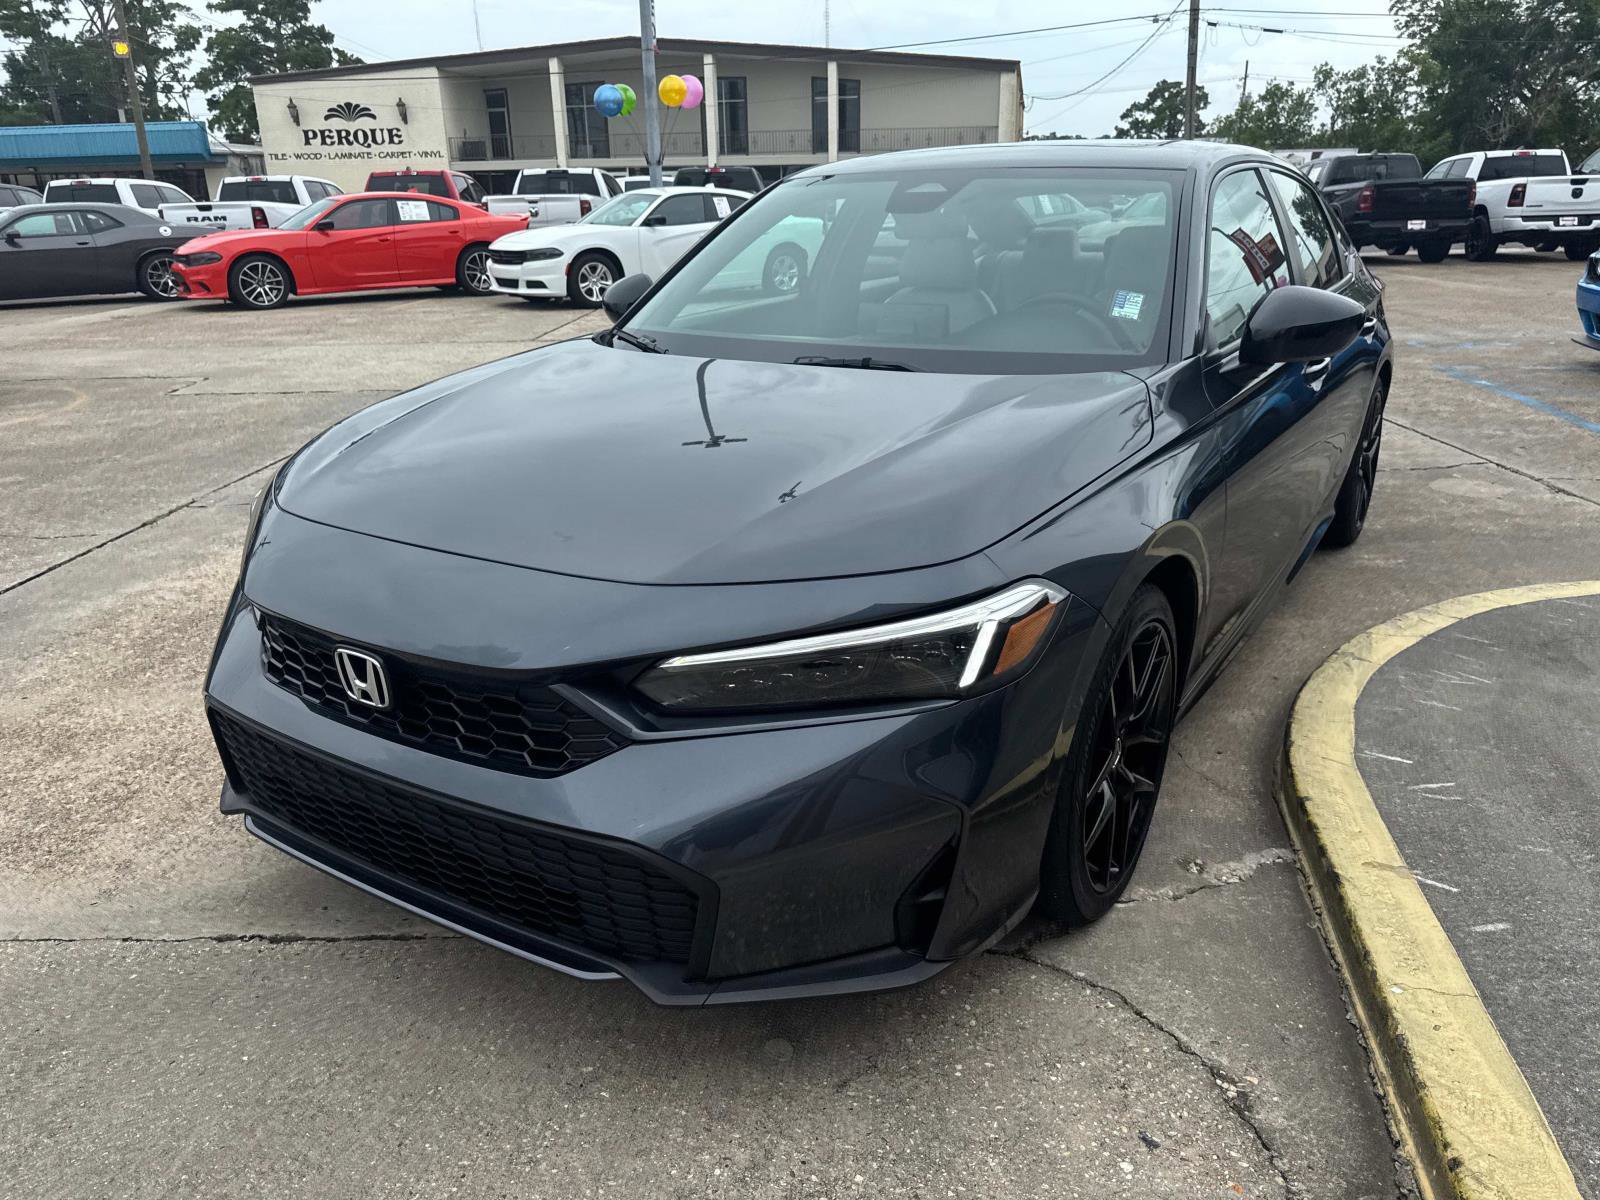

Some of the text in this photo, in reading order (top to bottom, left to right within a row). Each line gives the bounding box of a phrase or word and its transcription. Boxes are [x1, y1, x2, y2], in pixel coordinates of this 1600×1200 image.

[302, 128, 403, 148] PERQUE
[268, 150, 444, 161] TILE WOOD LAMINATE CARPET VINYL
